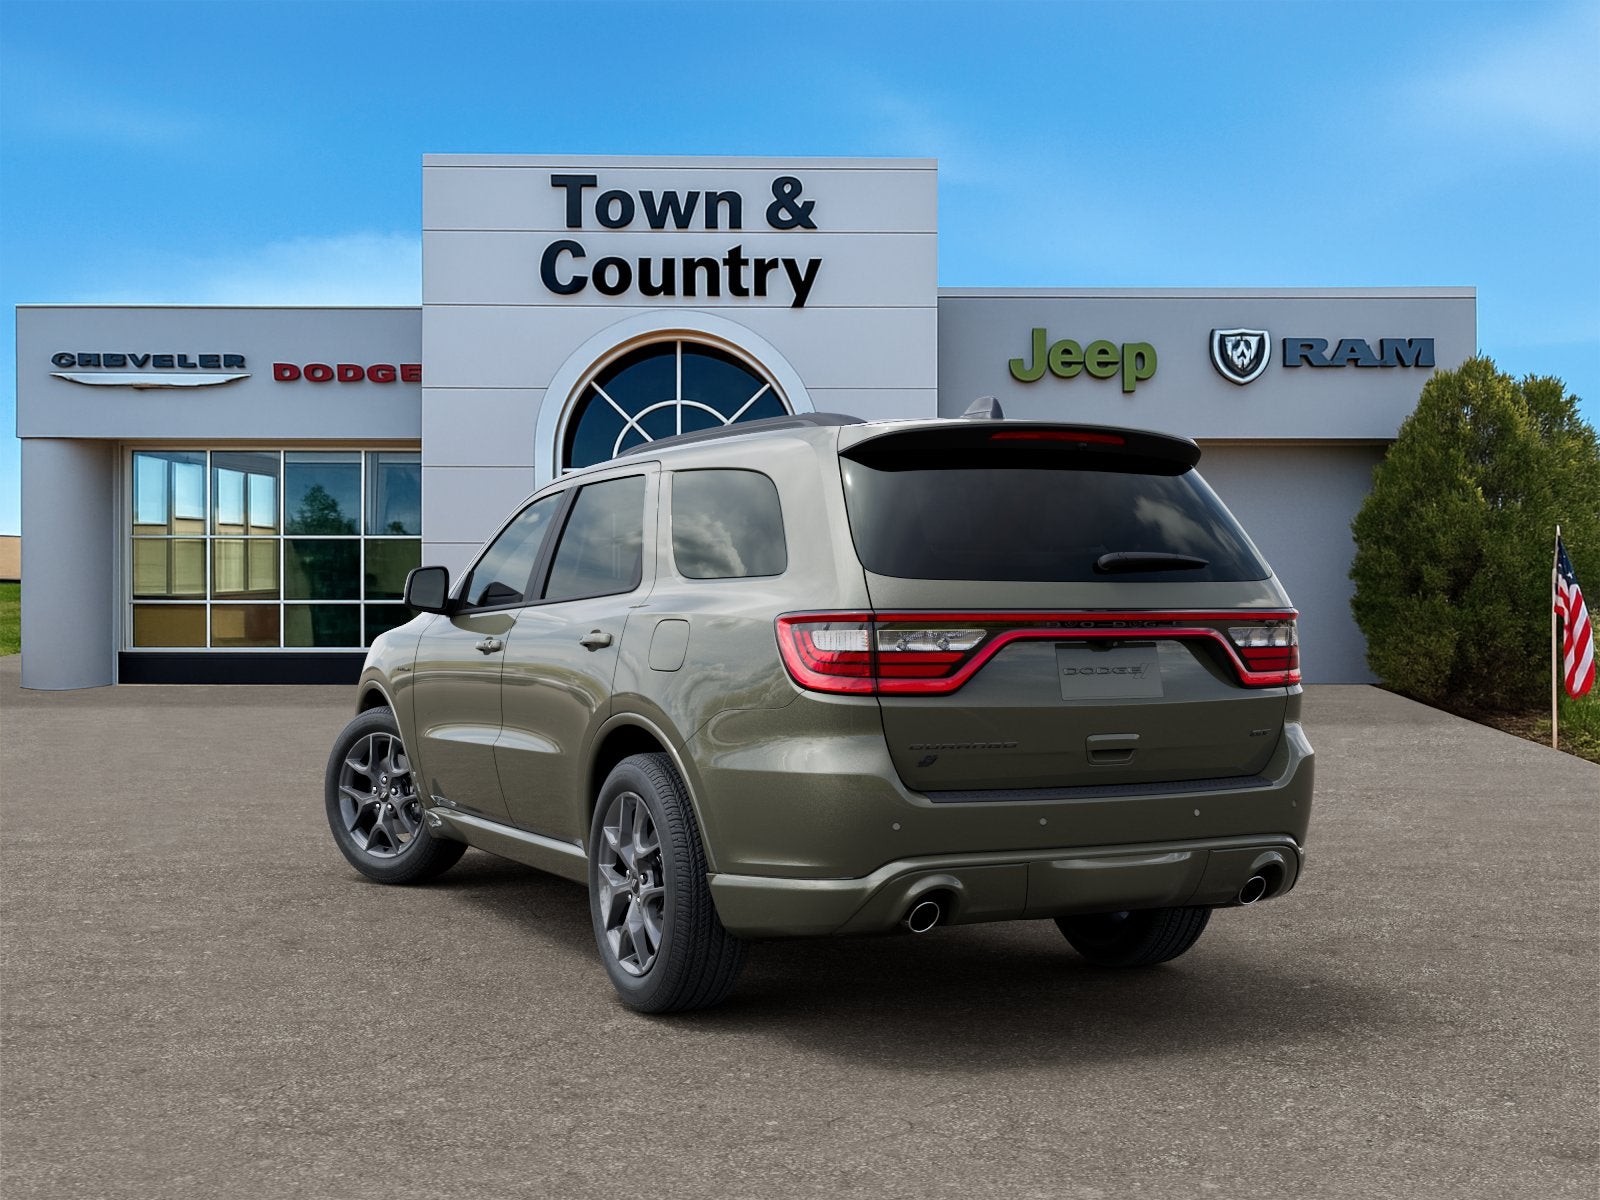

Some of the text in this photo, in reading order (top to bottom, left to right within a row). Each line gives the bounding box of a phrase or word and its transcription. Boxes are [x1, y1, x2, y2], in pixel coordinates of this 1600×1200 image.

[550, 174, 818, 231] Town &
[539, 239, 823, 308] Country
[272, 362, 422, 383] DODGE
[1008, 327, 1158, 393] Jeep
[1282, 337, 1436, 368] RAM
[1062, 667, 1143, 676] DODGE
